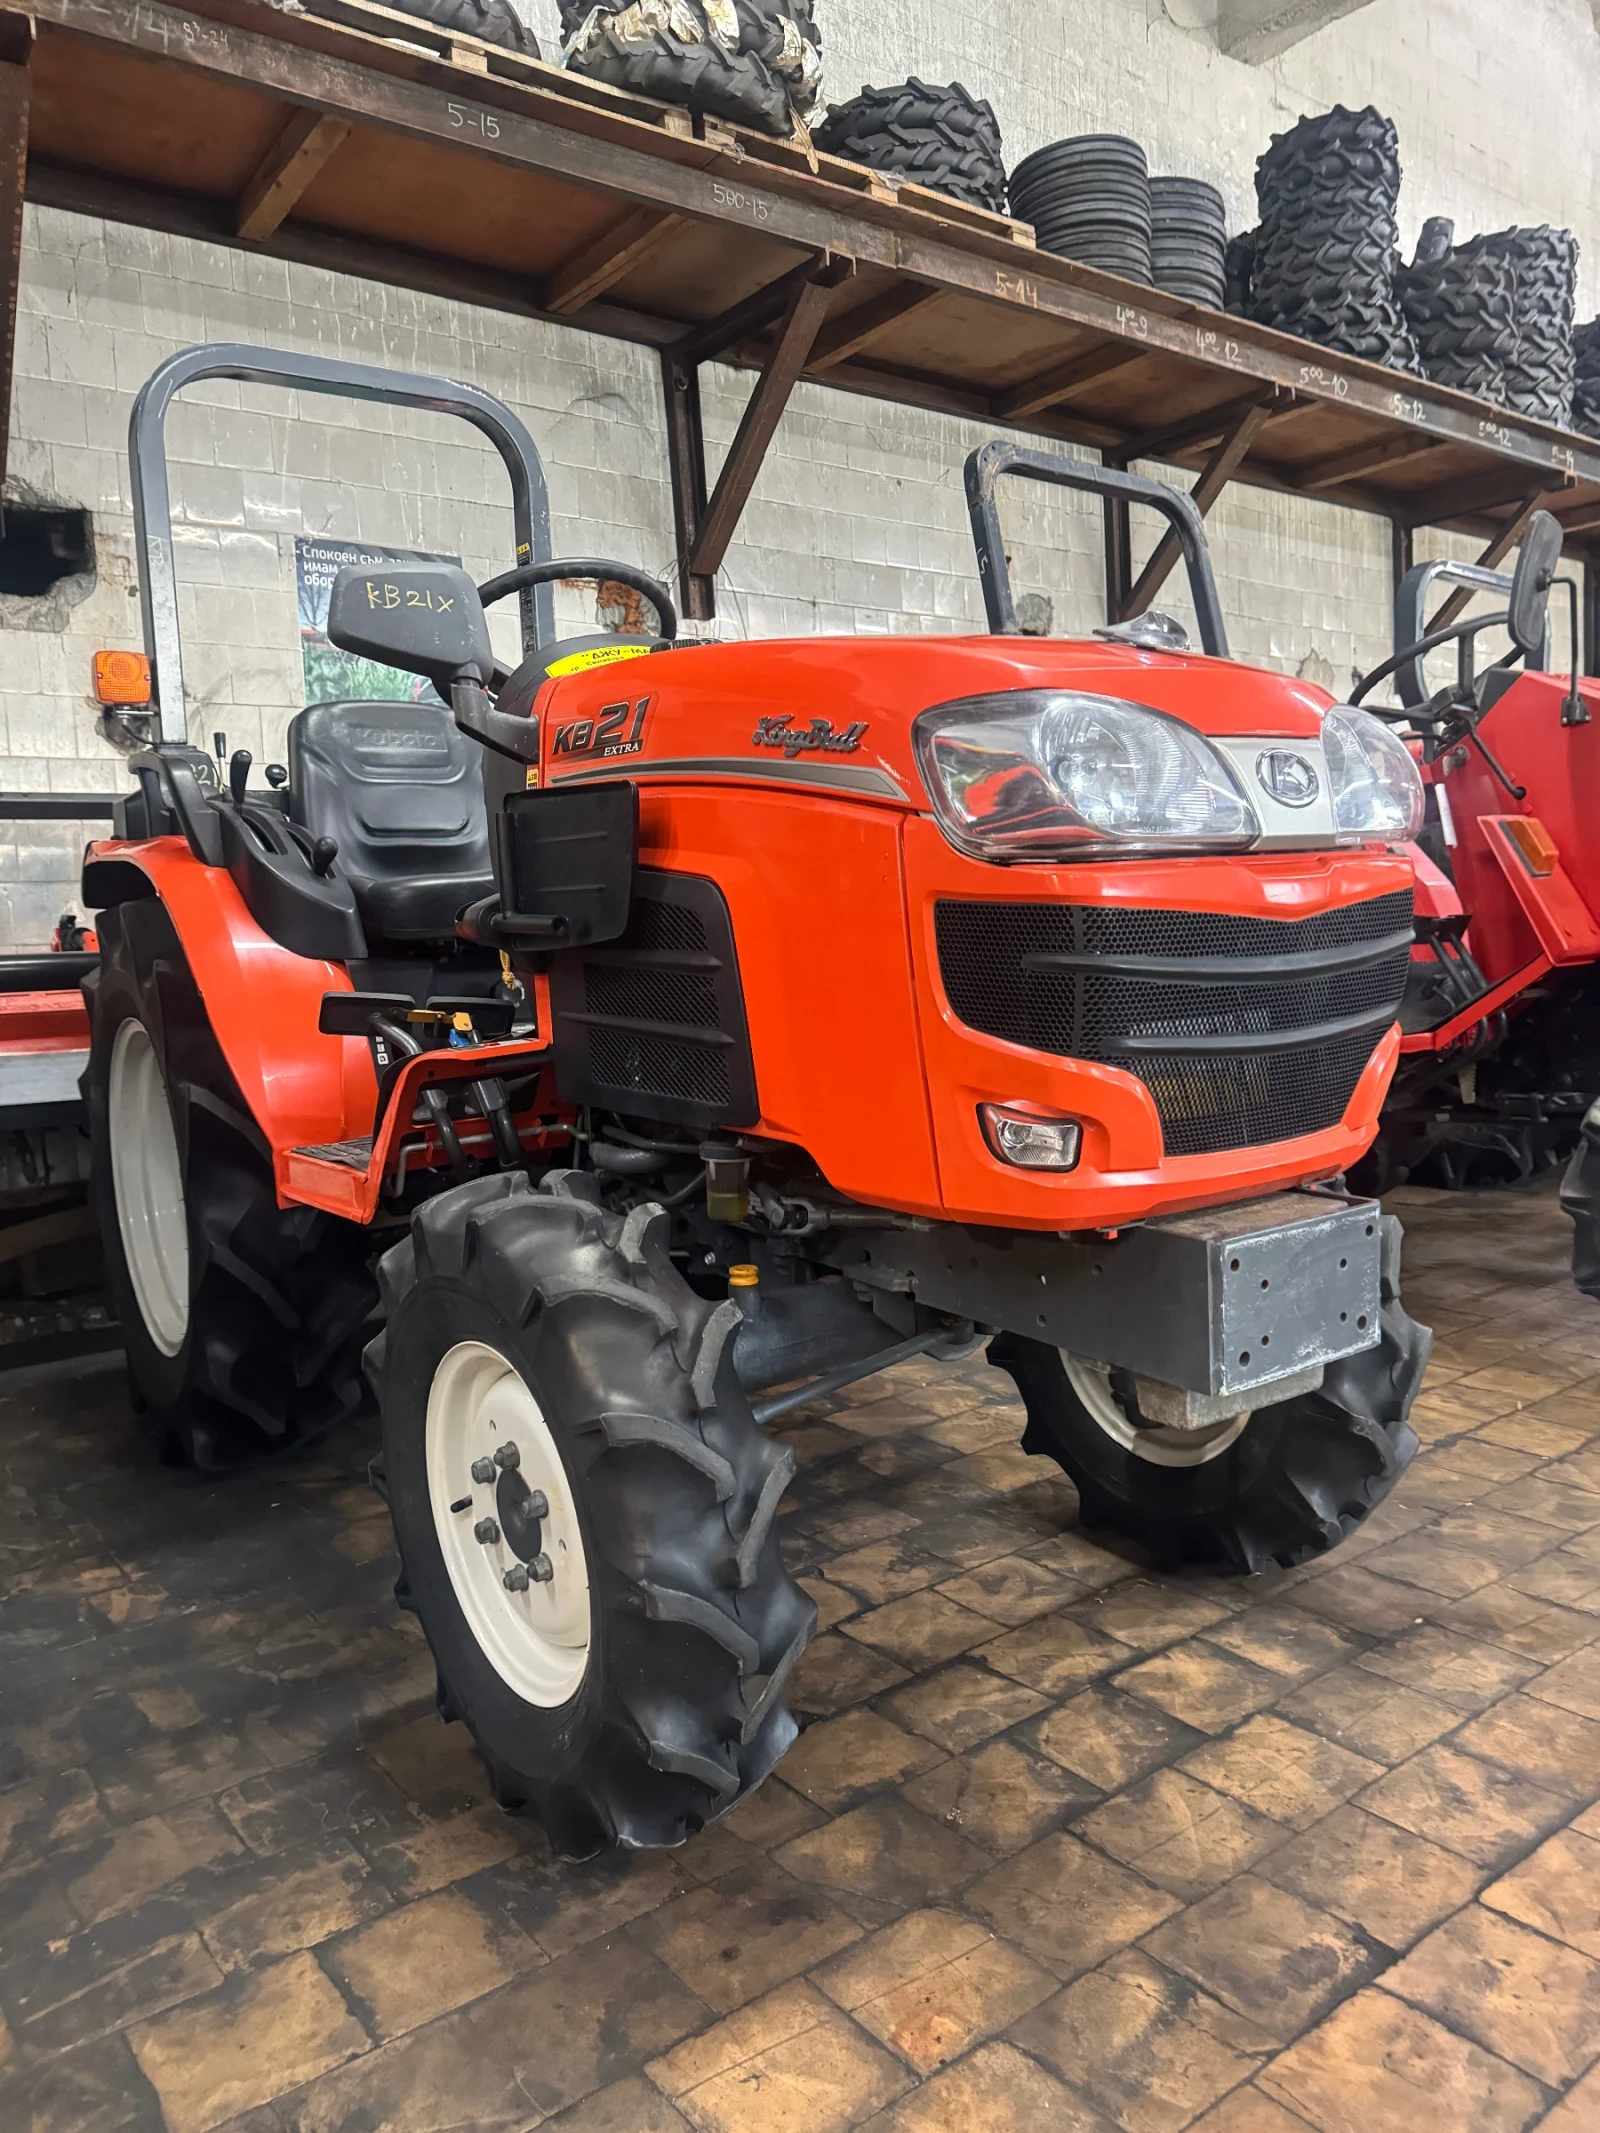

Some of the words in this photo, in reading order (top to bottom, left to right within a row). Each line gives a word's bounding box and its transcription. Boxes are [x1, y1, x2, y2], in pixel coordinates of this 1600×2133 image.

[447, 102, 500, 138] 5-15
[713, 183, 768, 220] 500-15
[995, 270, 1038, 309] 5-14
[303, 545, 357, 564] Спокоен
[303, 560, 338, 573] имам
[552, 695, 651, 755] KB21
[603, 742, 640, 757] EXTRA
